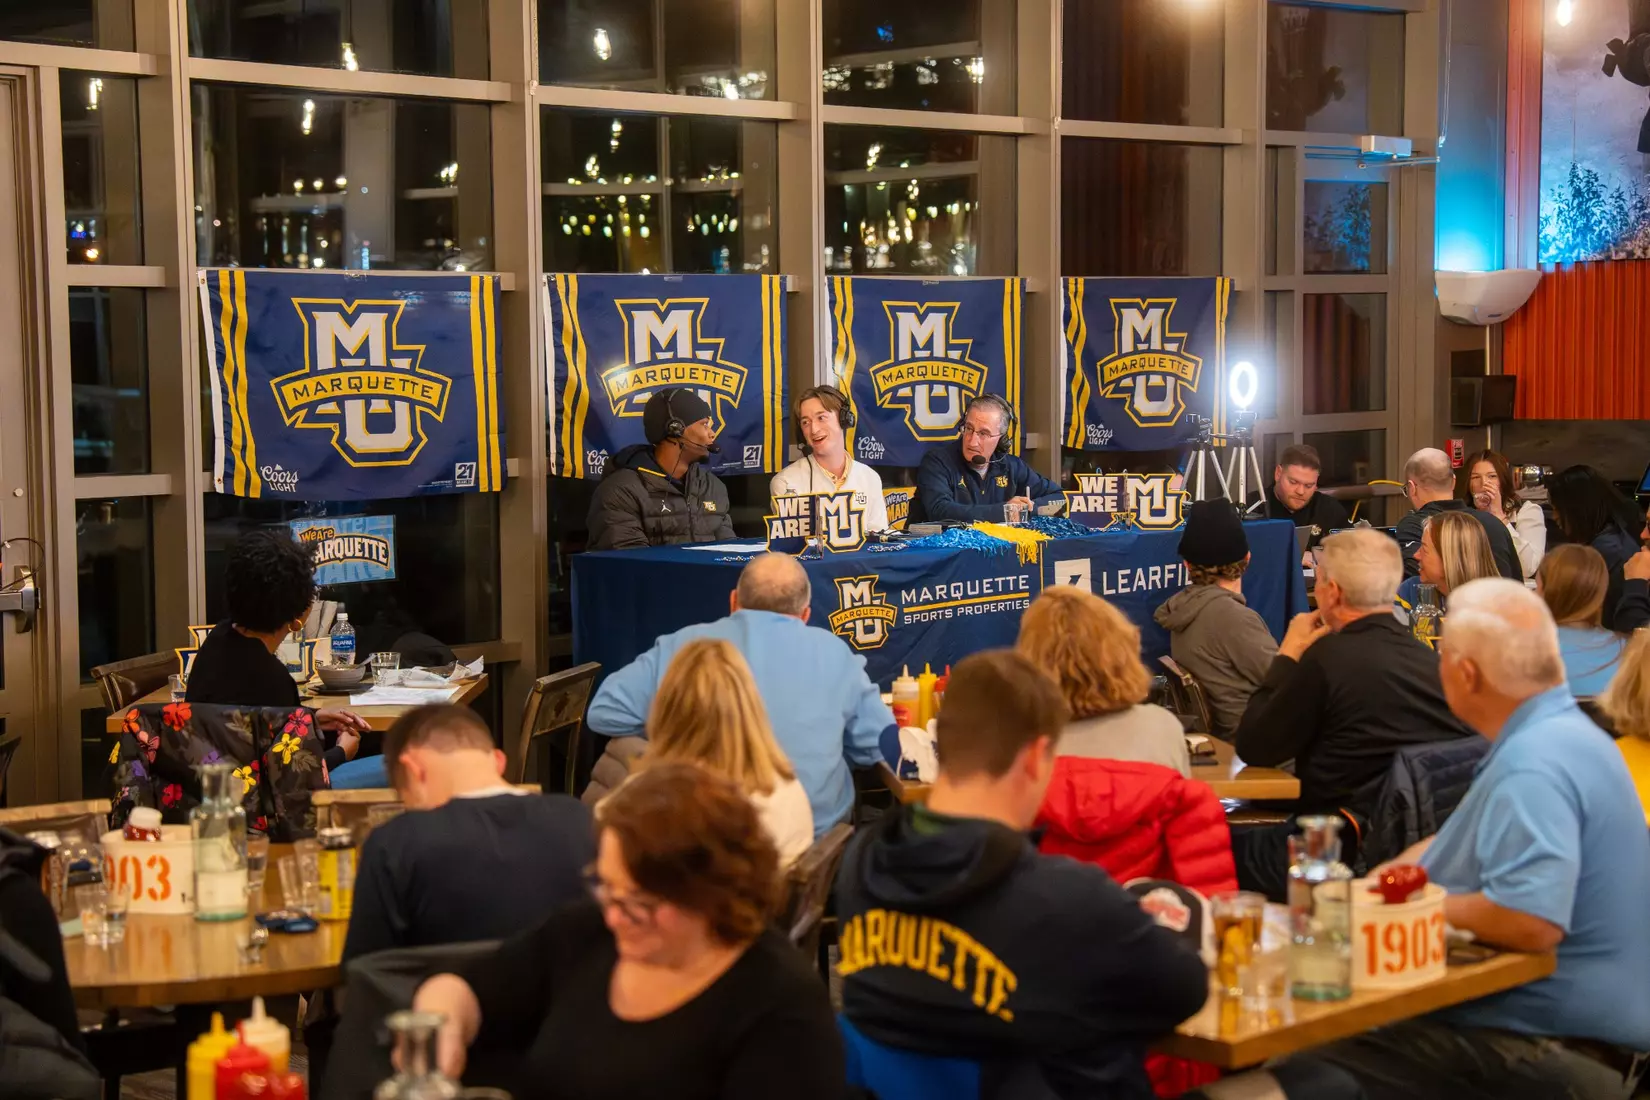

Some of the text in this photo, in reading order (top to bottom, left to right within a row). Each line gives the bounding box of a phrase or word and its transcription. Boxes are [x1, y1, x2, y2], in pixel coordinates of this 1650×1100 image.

[882, 365, 975, 385] MARQUETTE
[1109, 357, 1189, 377] MARQUETTE
[292, 376, 433, 401] MARQUETTE
[615, 367, 733, 392] MARQUETTE
[1086, 424, 1113, 438] Coors
[1089, 437, 1110, 445] LIGHT
[858, 436, 885, 452] Coors
[860, 451, 883, 460] LIGHT
[260, 465, 299, 483] Coors
[457, 464, 474, 479] 21
[269, 482, 296, 492] LIGHT
[1080, 476, 1119, 494] WE
[776, 496, 811, 518] WE
[1070, 495, 1119, 512] ARE
[1127, 478, 1178, 525] MU
[770, 518, 811, 540] ARE
[819, 495, 860, 547] MU
[314, 537, 388, 563] ARQUETTE
[901, 575, 1029, 605] MARQUETTE
[835, 608, 891, 624] MARQUETTE
[903, 599, 1030, 625] SPORTS PROPERTIES
[1361, 912, 1445, 977] 1903
